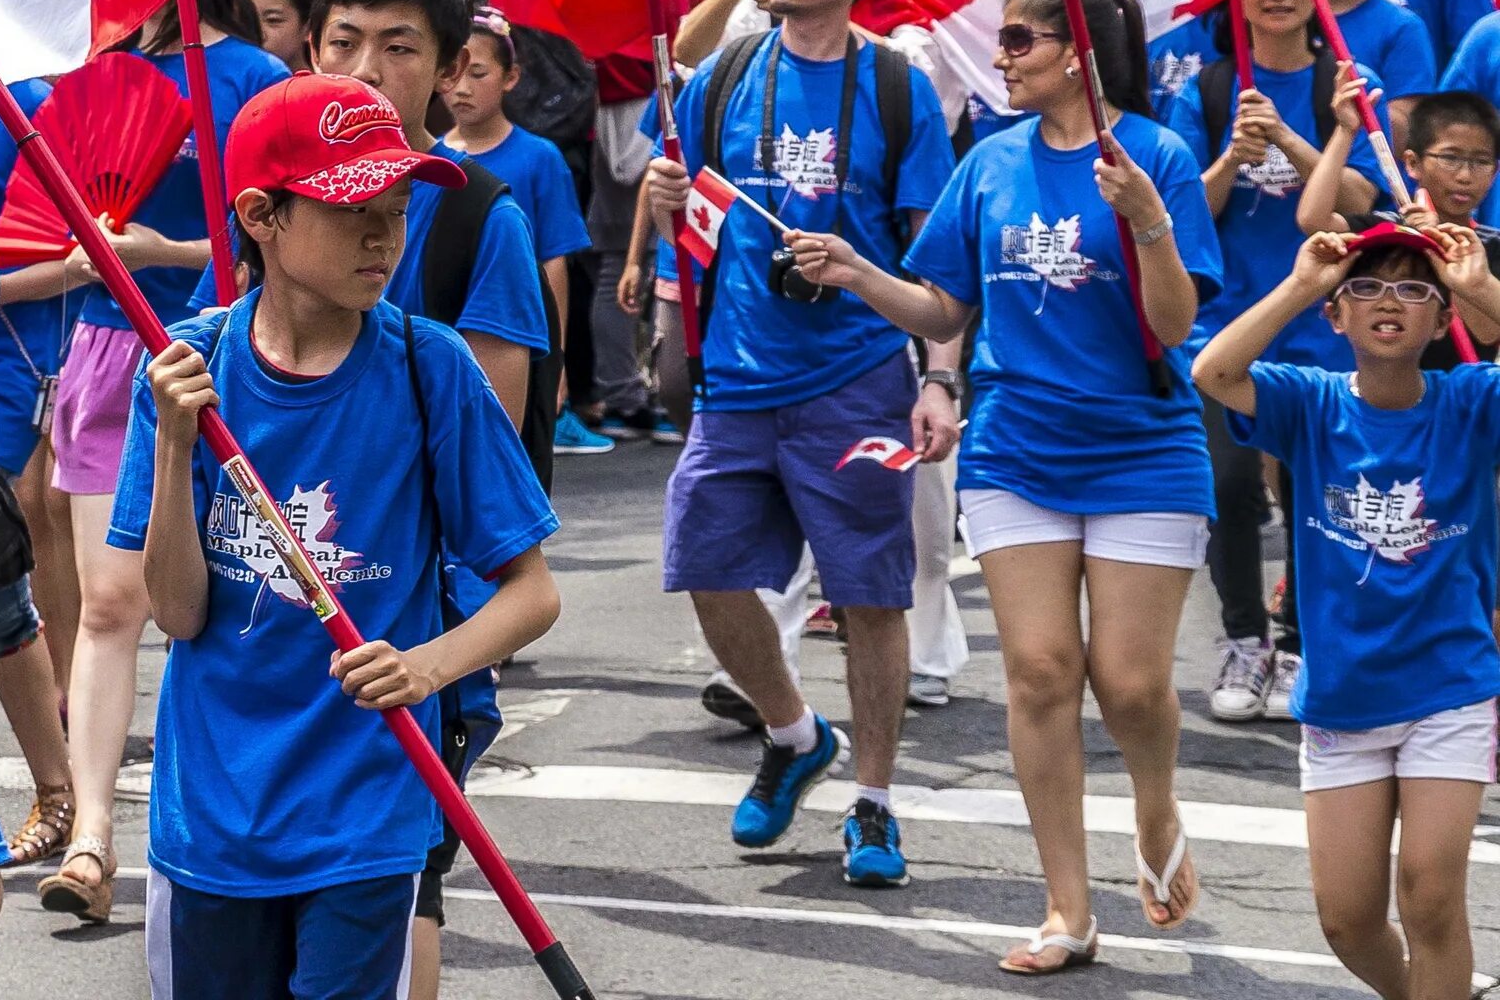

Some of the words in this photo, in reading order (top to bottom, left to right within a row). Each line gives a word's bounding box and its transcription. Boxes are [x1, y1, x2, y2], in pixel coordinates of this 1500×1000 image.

[207, 533, 276, 560] Maple
[306, 546, 343, 562] eaf
[269, 563, 392, 583] Ademic
